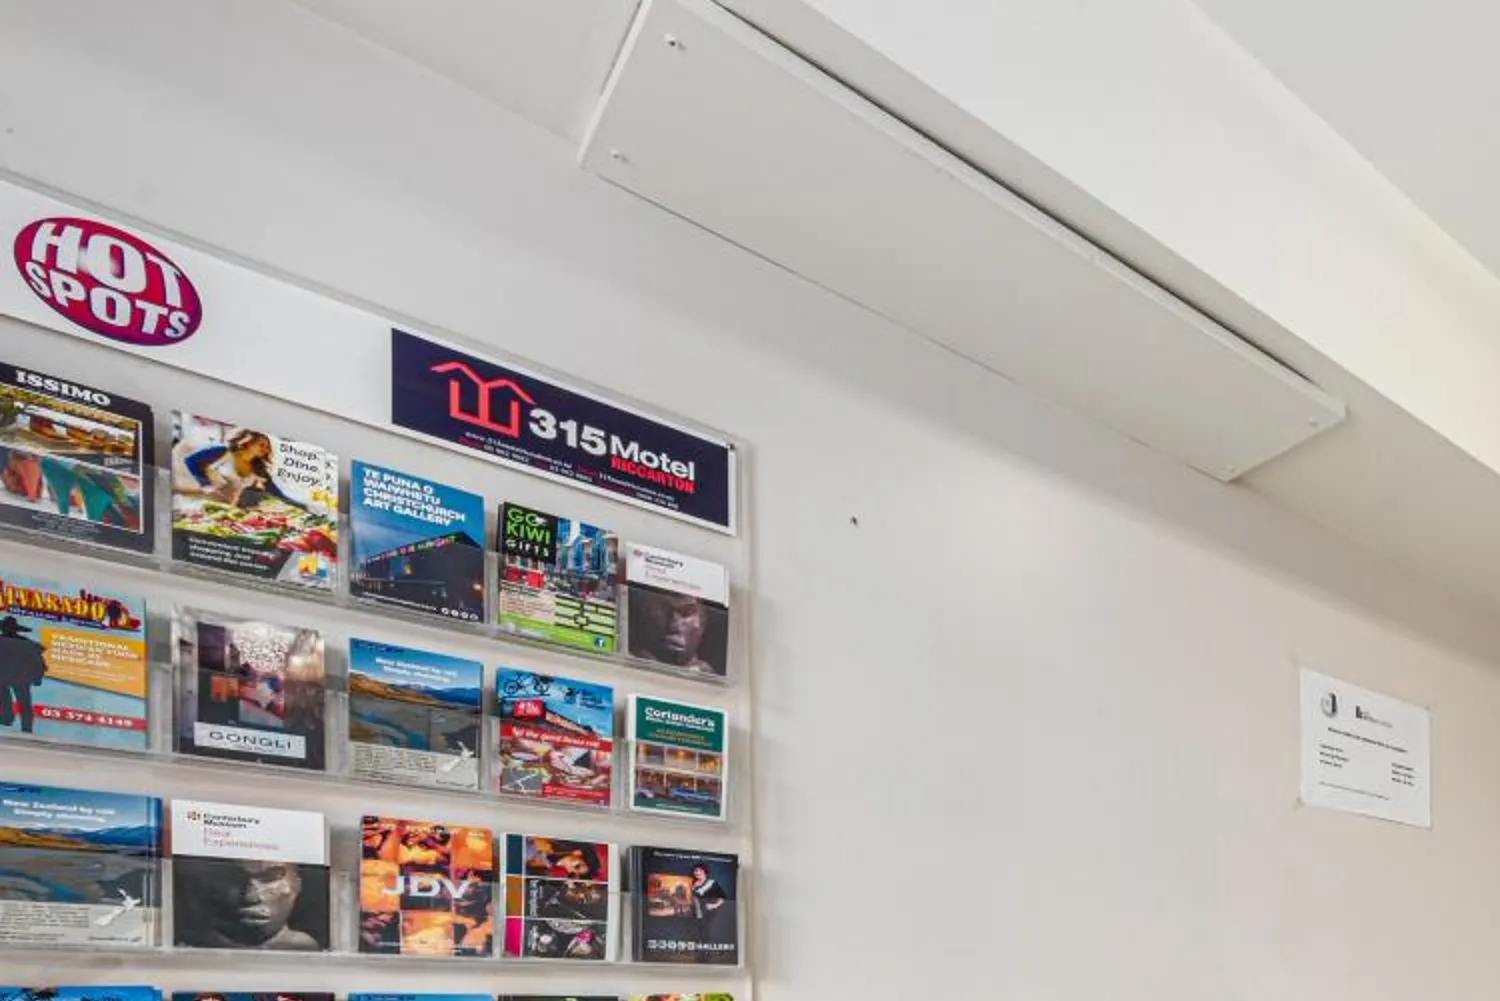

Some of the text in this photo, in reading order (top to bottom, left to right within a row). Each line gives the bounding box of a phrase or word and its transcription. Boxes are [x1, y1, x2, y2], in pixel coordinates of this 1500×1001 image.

[31, 223, 184, 308] HOT
[25, 261, 190, 338] SPOTS
[16, 370, 111, 407] ISSIMO
[529, 408, 606, 456] 315
[611, 434, 696, 480] Motel
[363, 468, 382, 480] TE
[383, 472, 420, 490] PUNA
[611, 454, 696, 494] RICCARTON
[363, 487, 466, 522] CHRISTCHURCH
[364, 497, 451, 527] ART GALLERY
[508, 508, 539, 526] GO
[507, 521, 550, 545] KIWI
[209, 731, 291, 750] GONGLI
[382, 875, 471, 899] JDV
